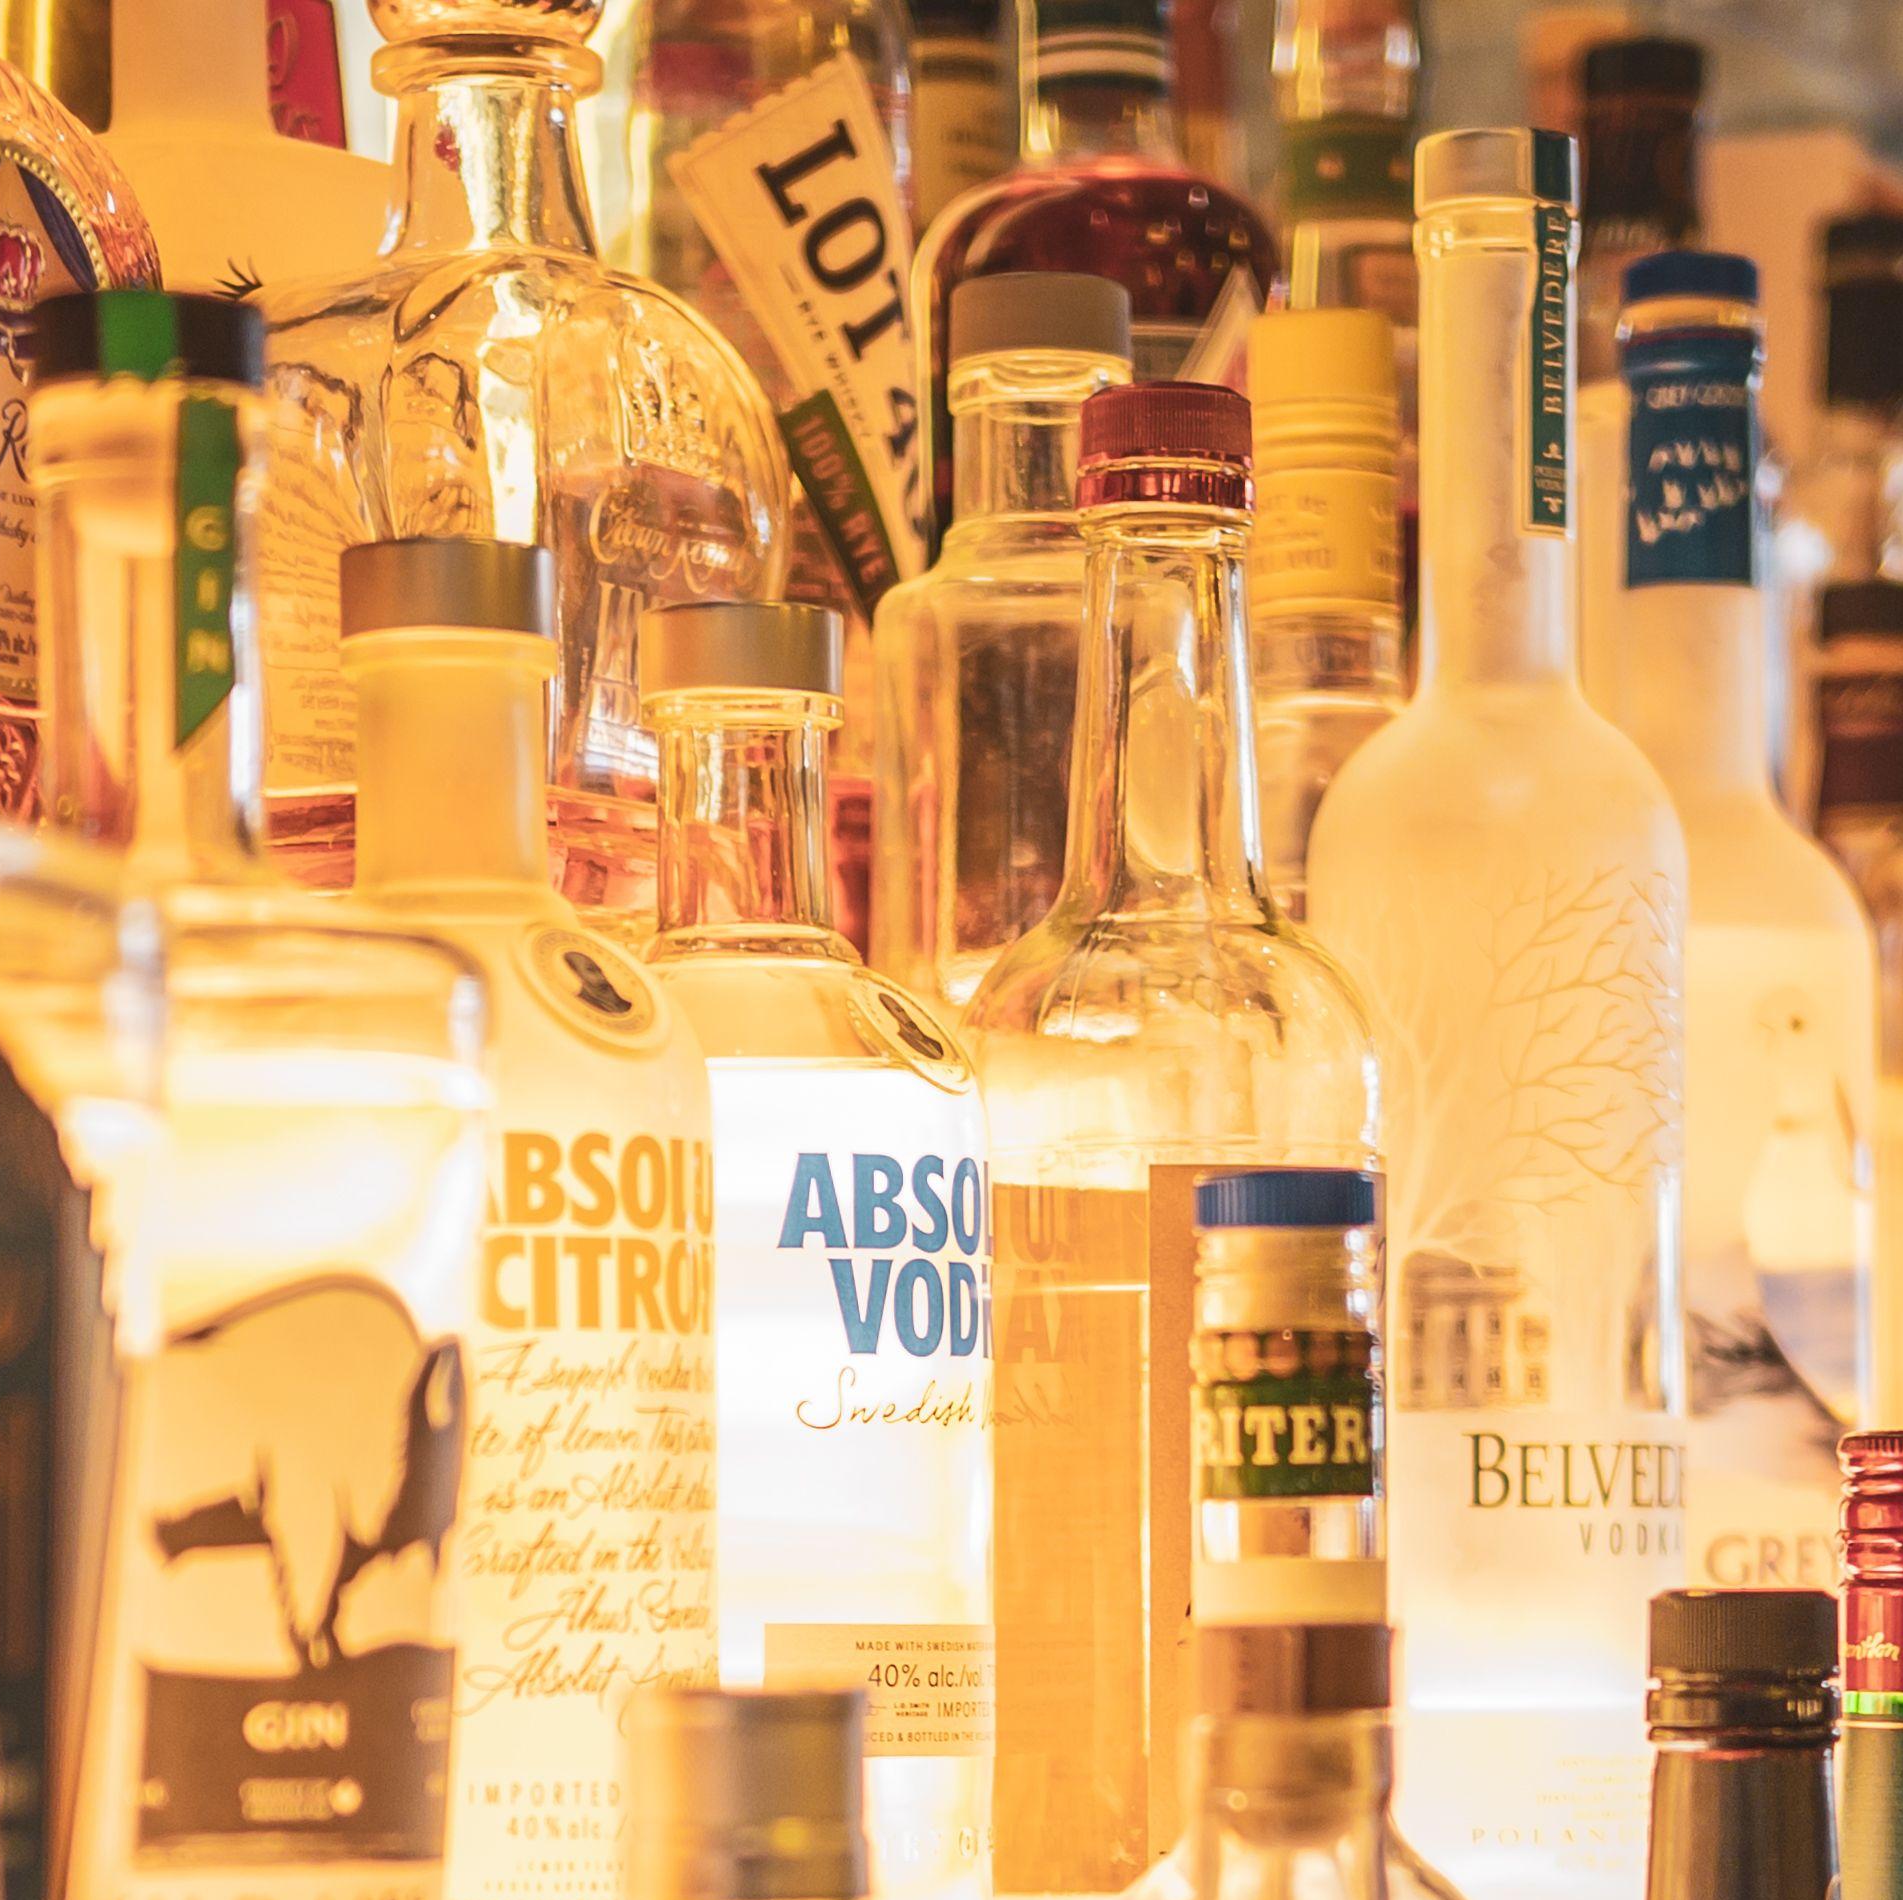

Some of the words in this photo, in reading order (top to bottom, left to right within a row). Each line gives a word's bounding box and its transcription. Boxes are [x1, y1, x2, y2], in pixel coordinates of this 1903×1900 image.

[1541, 212, 1574, 416] BELVEDERE
[796, 1366, 976, 1430] Swedish
[855, 1640, 891, 1651] MADE
[895, 1640, 923, 1651] WITH
[867, 1663, 921, 1688] 40%
[907, 1731, 949, 1742] BOTTLED
[467, 1780, 622, 1809] IMPORTED
